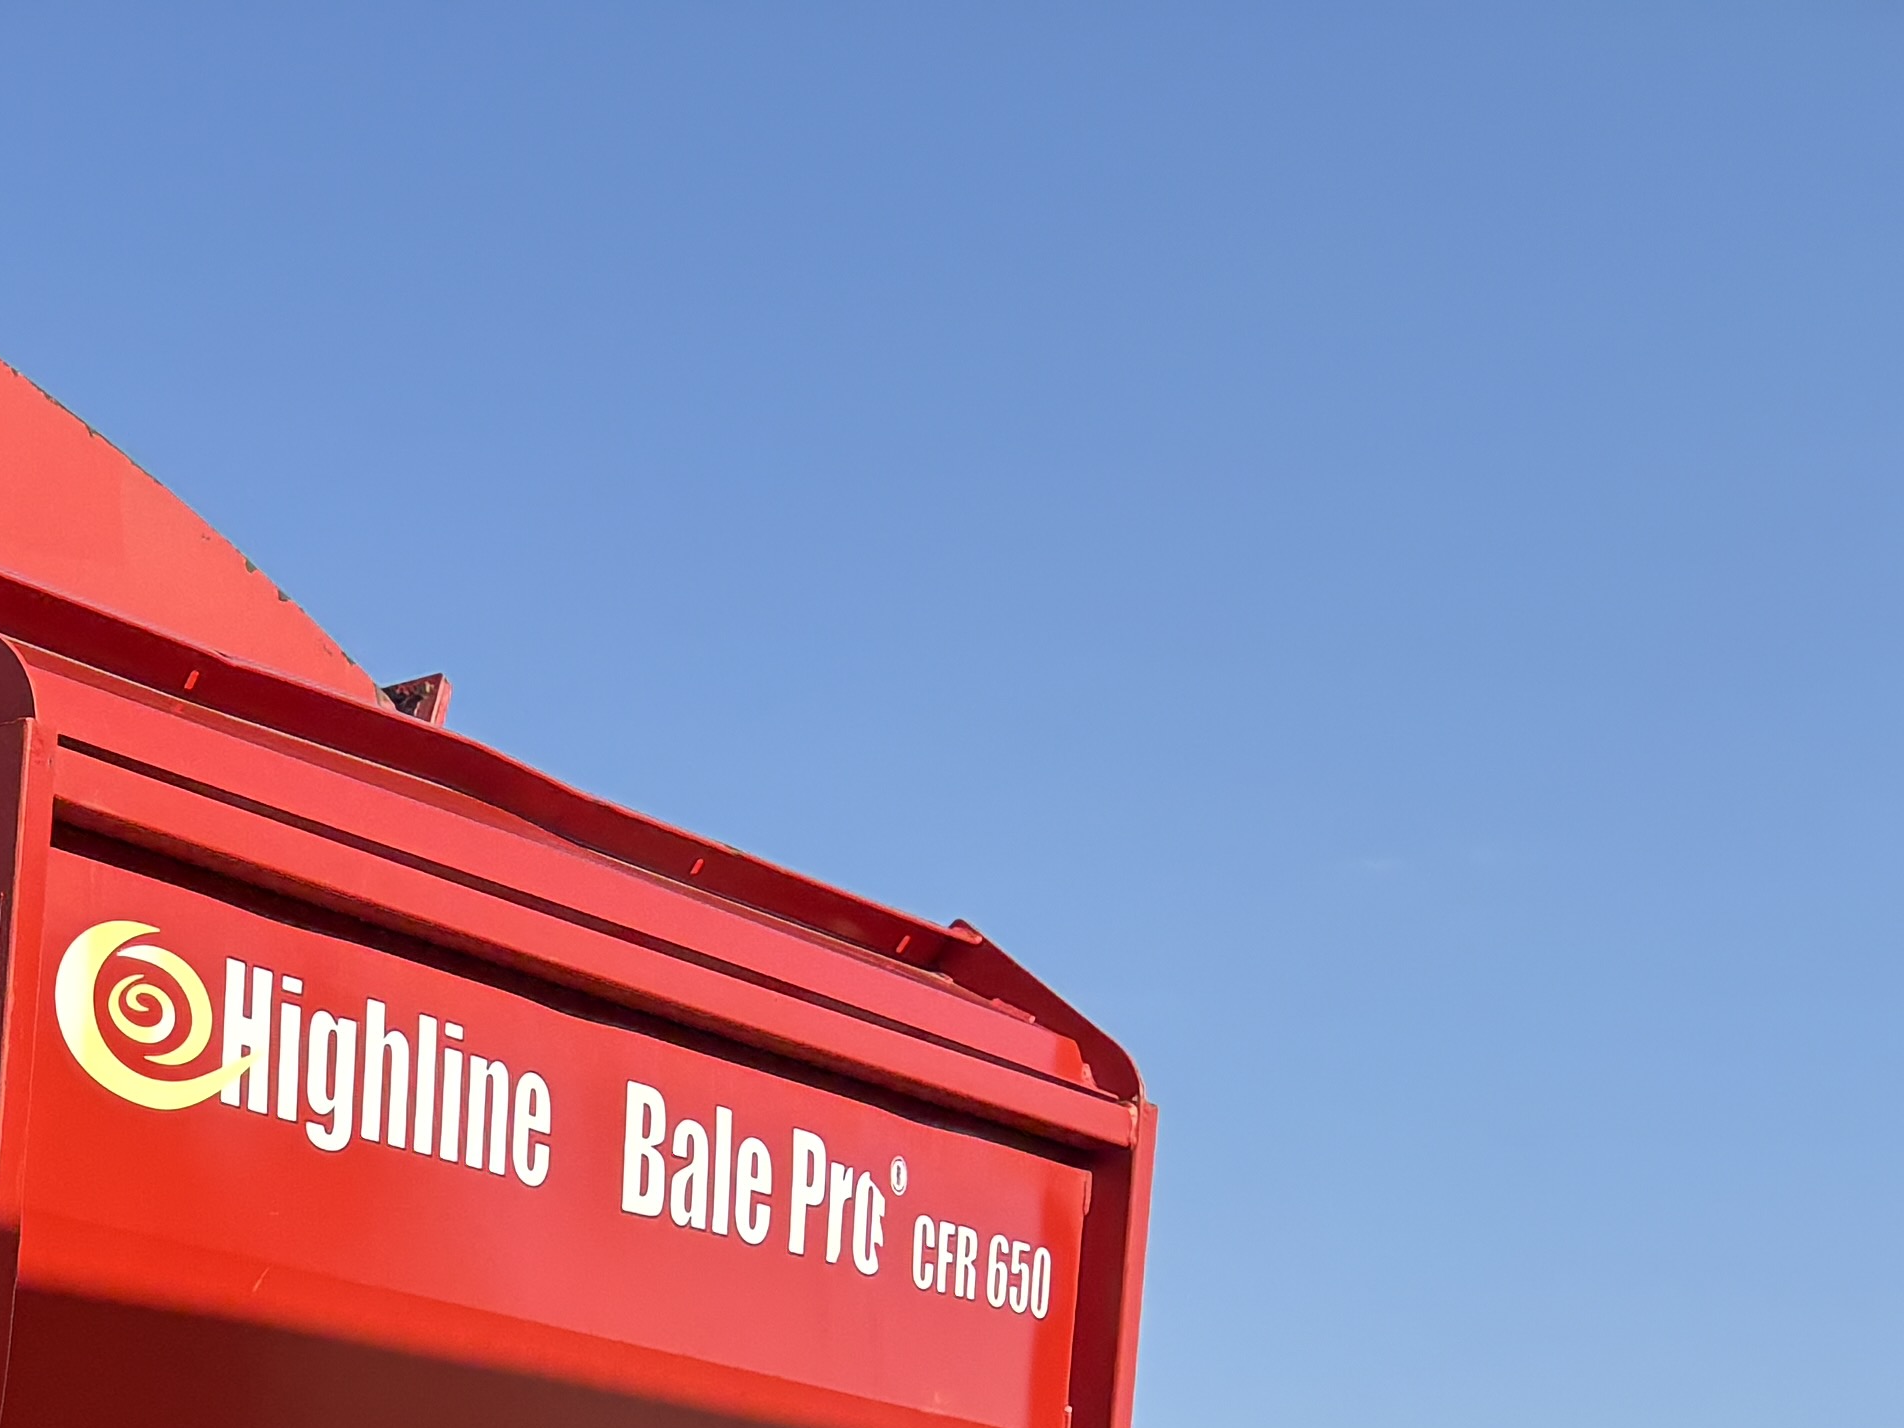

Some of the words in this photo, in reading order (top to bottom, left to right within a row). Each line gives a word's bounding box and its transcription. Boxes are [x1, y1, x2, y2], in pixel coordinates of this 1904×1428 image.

[219, 955, 552, 1188] Highline
[621, 1079, 773, 1246] Bale
[912, 1214, 979, 1301] CFR
[986, 1233, 1052, 1320] 650
